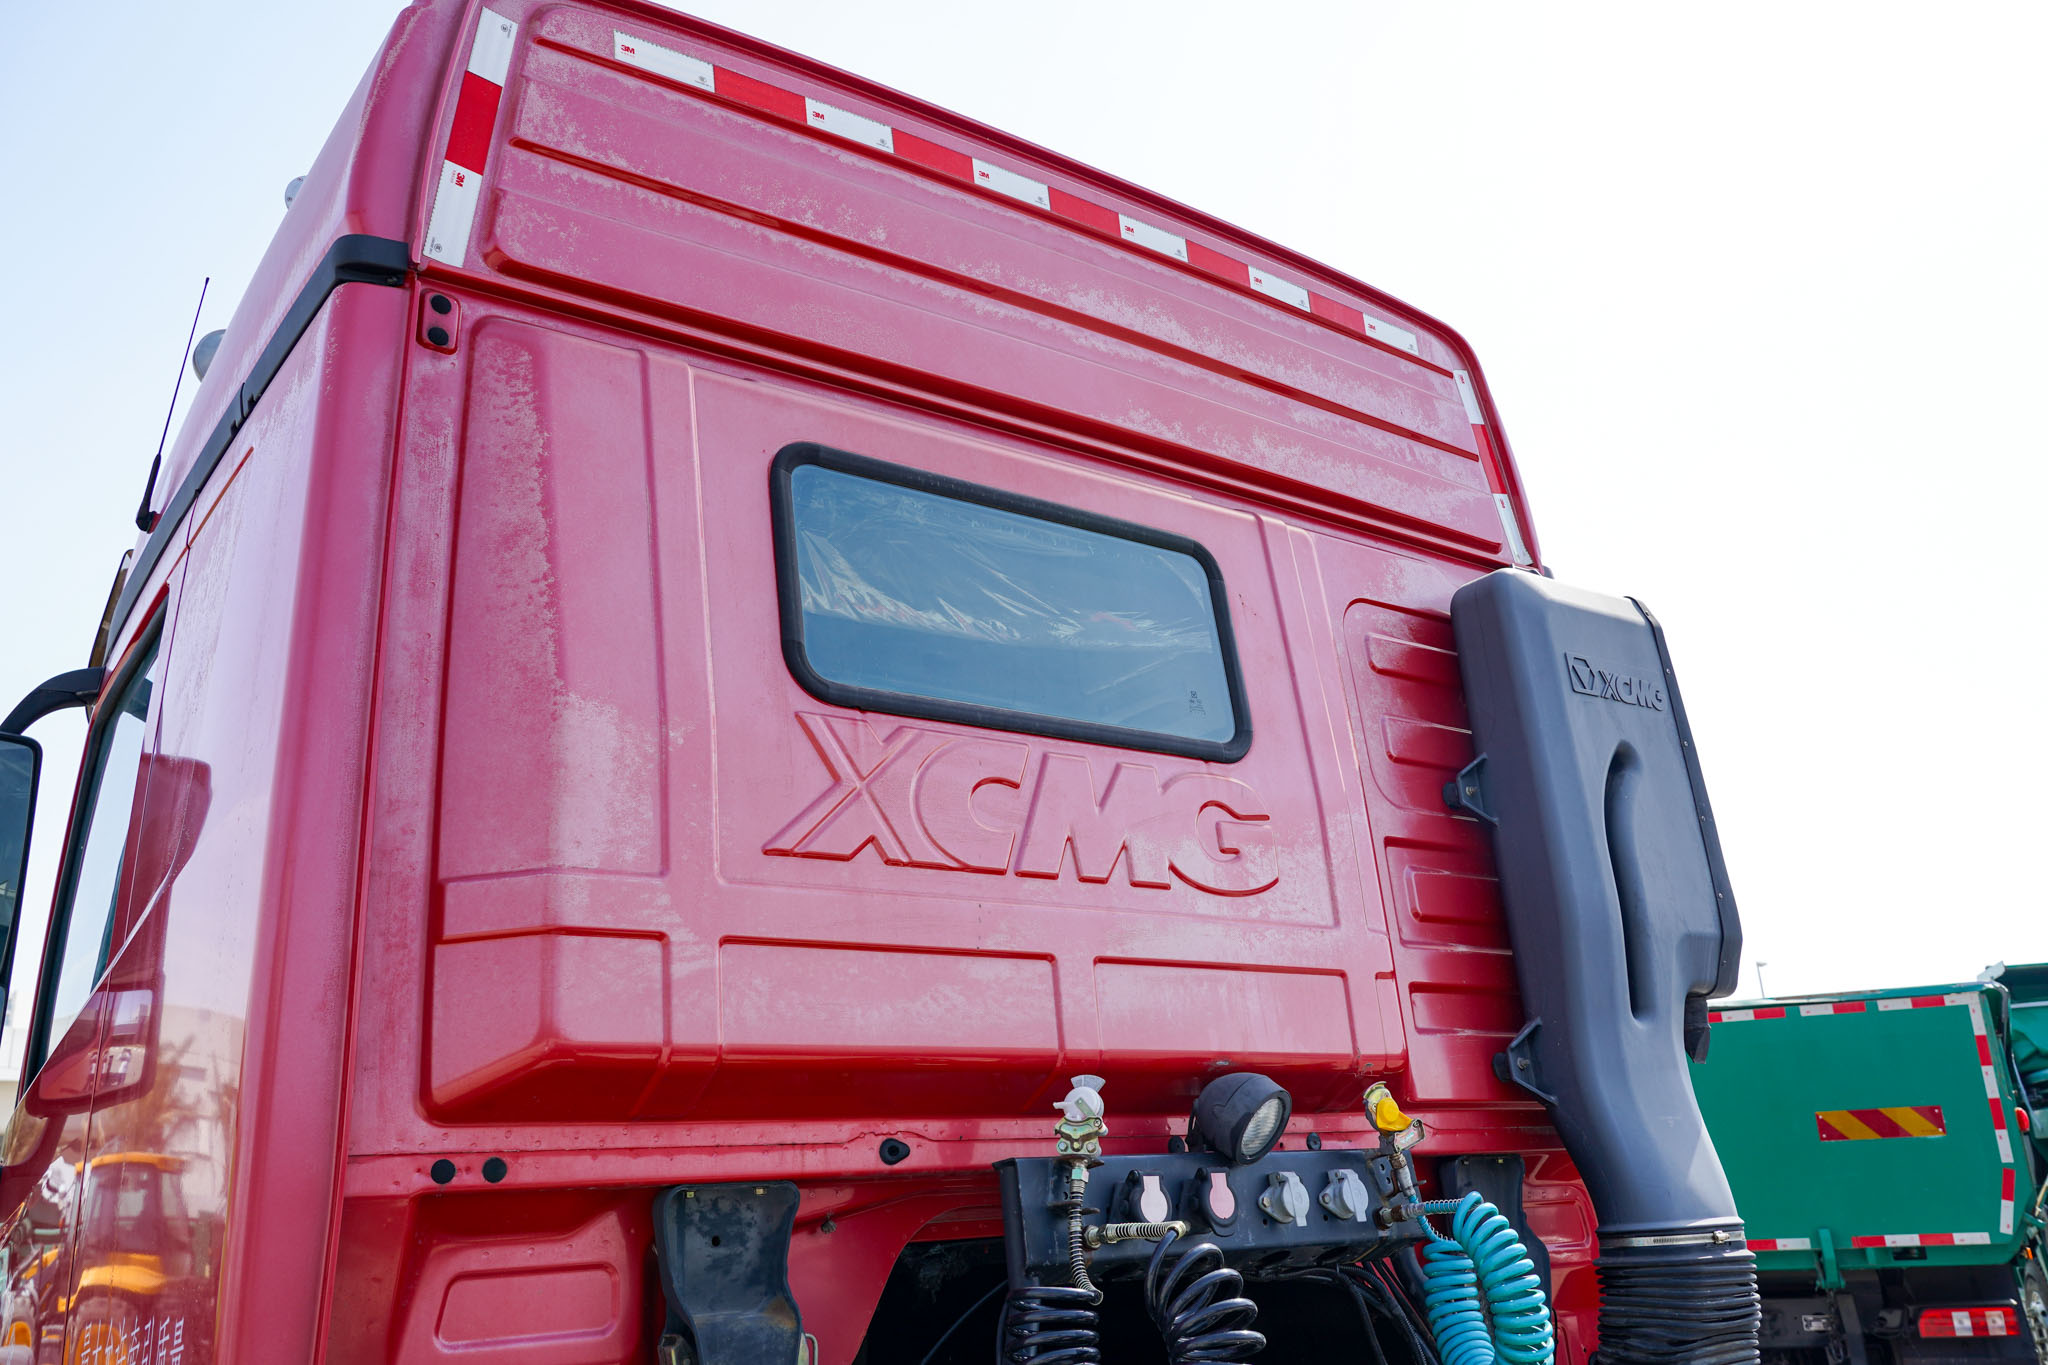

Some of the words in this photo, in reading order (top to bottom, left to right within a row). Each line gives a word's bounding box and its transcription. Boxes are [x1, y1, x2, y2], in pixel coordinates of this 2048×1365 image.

[621, 44, 635, 54] 3M
[812, 111, 824, 120] 3M
[455, 172, 465, 187] 3M
[978, 170, 989, 179] 3M
[1598, 669, 1666, 712] XCMG
[762, 711, 1280, 898] XCMG
